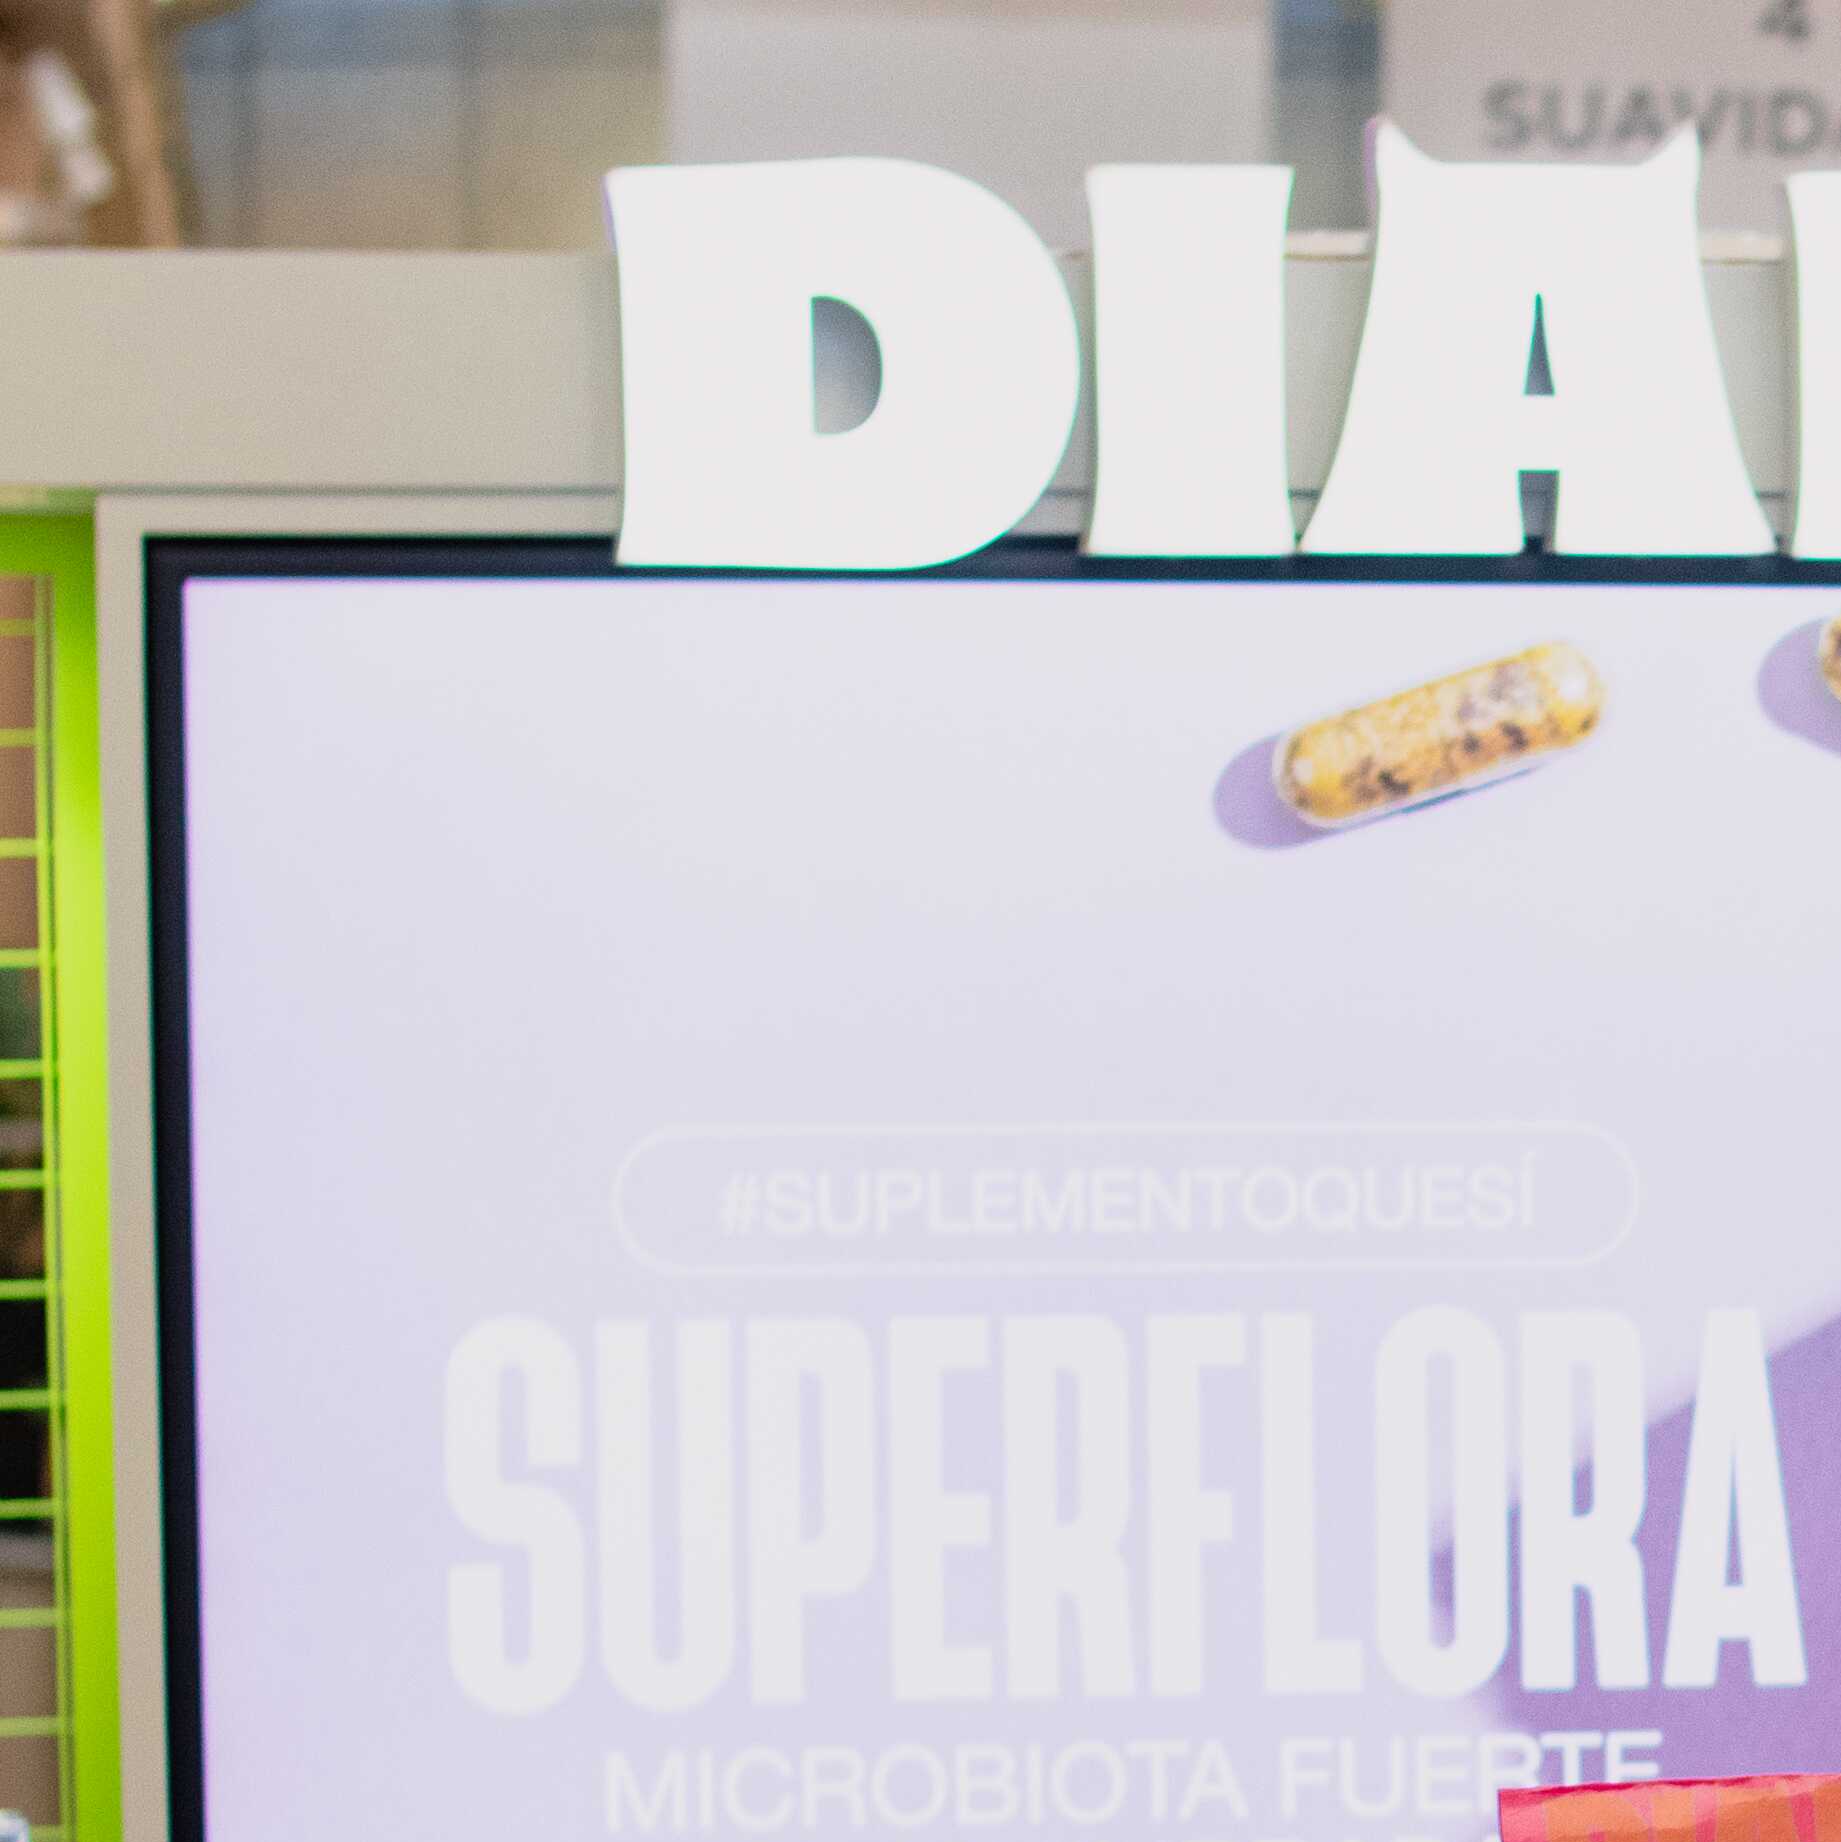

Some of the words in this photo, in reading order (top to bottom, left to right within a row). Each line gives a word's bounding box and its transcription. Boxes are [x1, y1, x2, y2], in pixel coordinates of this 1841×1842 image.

[716, 1151, 1539, 1238] #SUPLEMENTOQUESÍ
[442, 1305, 1806, 1719] SUPERFLORA
[605, 1737, 1263, 1834] MICROBIOTA
[1279, 1730, 1663, 1822] FUERTE
